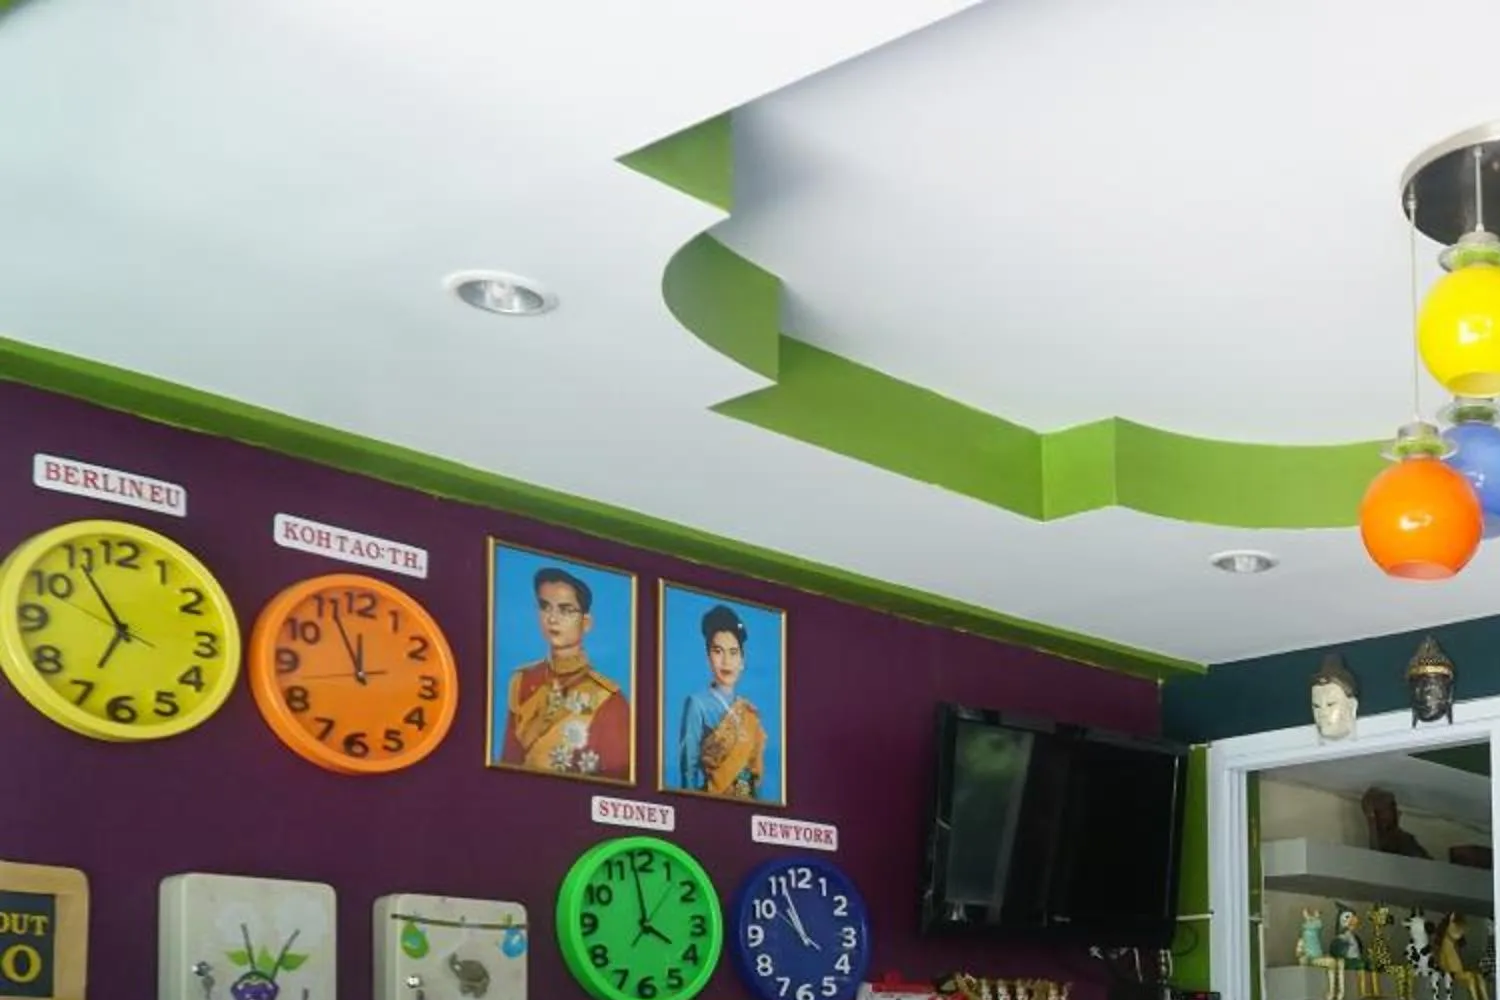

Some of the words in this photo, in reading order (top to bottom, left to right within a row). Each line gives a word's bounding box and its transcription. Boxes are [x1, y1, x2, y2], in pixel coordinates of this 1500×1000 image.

[99, 540, 140, 570] 12
[156, 560, 167, 585] 1
[31, 570, 74, 599] 10
[179, 587, 204, 615] 2
[345, 592, 377, 619] 12
[19, 603, 49, 632] 9
[388, 611, 398, 633] 1
[284, 617, 320, 645] 10
[194, 631, 218, 659] 3
[407, 636, 428, 661] 2
[34, 645, 63, 674] 8
[276, 648, 299, 673] 9
[178, 665, 205, 692] 4
[418, 676, 438, 700] 3
[70, 679, 94, 706] 7
[154, 691, 180, 717] 5
[286, 686, 309, 712] 8
[106, 696, 138, 723] 6
[404, 707, 427, 731] 4
[314, 717, 335, 741] 7
[382, 729, 404, 752] 5
[343, 732, 368, 757] 6
[599, 800, 669, 825] SYDNEY
[605, 860, 625, 880] 11
[663, 862, 671, 881] 1
[788, 868, 812, 889] 12
[585, 883, 612, 906] 10
[679, 880, 696, 903] 2
[818, 877, 827, 897] 1
[753, 900, 776, 920] 10
[833, 895, 848, 917] 2
[581, 912, 598, 935] 9
[690, 915, 706, 937] 3
[748, 925, 765, 947] 9
[842, 927, 857, 948] 3
[590, 944, 609, 968] 8
[682, 943, 698, 965] 4
[757, 954, 773, 976] 8
[835, 954, 851, 974] 4
[612, 969, 629, 990] 7
[637, 976, 657, 999] 6
[667, 968, 684, 989] 5
[776, 977, 791, 997] 7
[821, 976, 837, 997] 5
